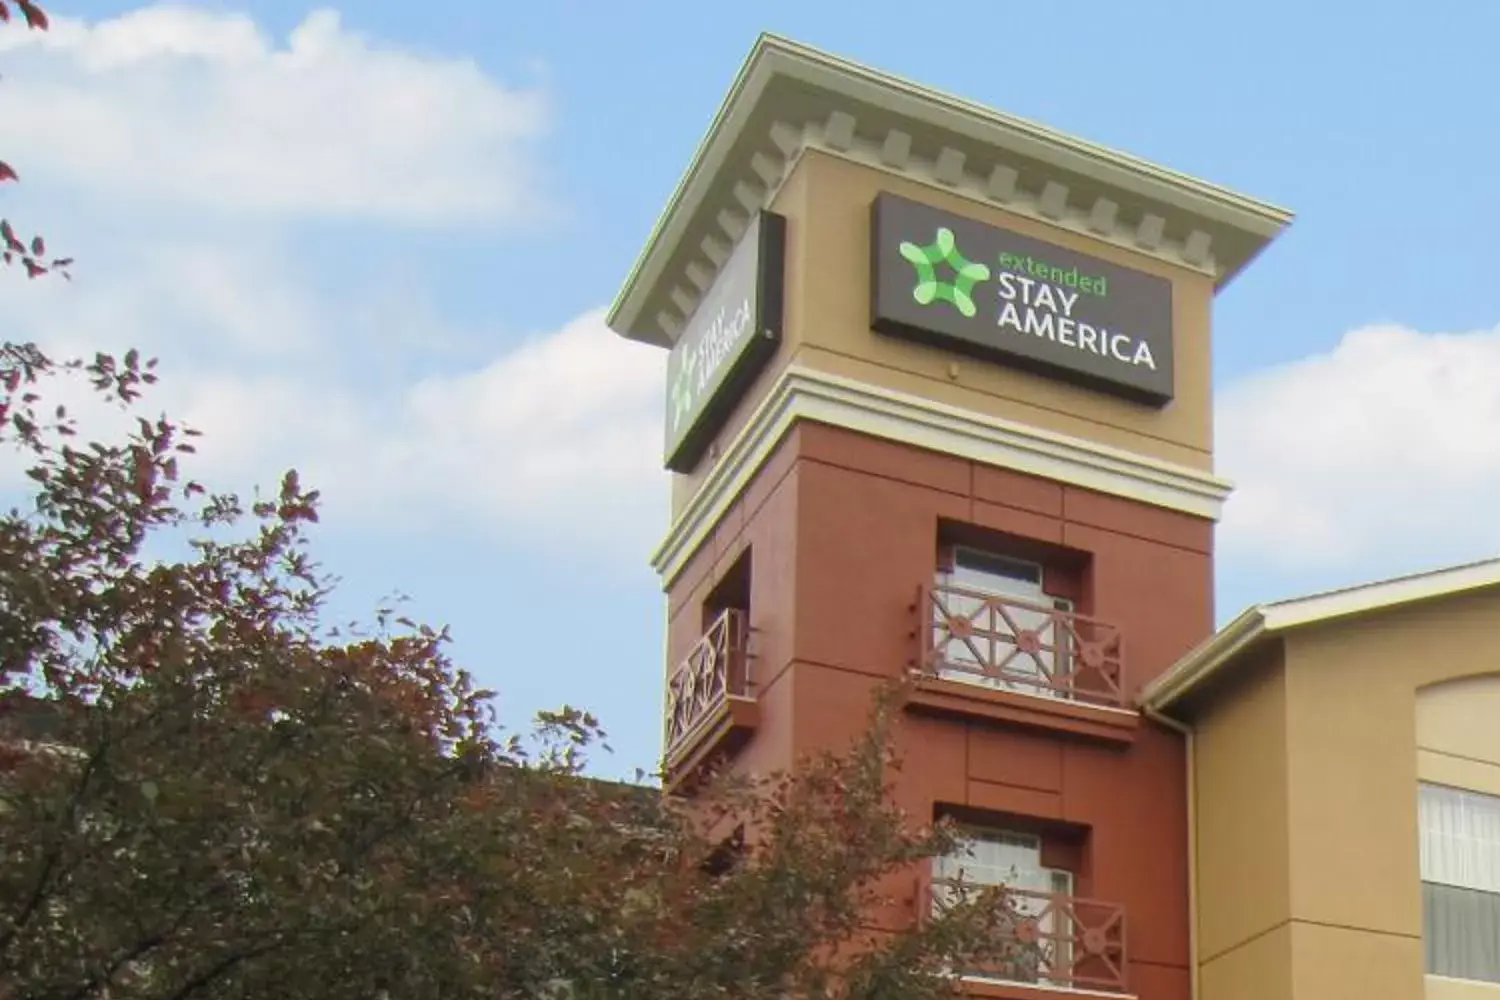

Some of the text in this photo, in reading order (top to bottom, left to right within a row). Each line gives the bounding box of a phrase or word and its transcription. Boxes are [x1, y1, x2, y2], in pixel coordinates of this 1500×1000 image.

[998, 272, 1079, 317] STAY
[1000, 252, 1106, 296] extended
[998, 302, 1157, 370] AMERICA
